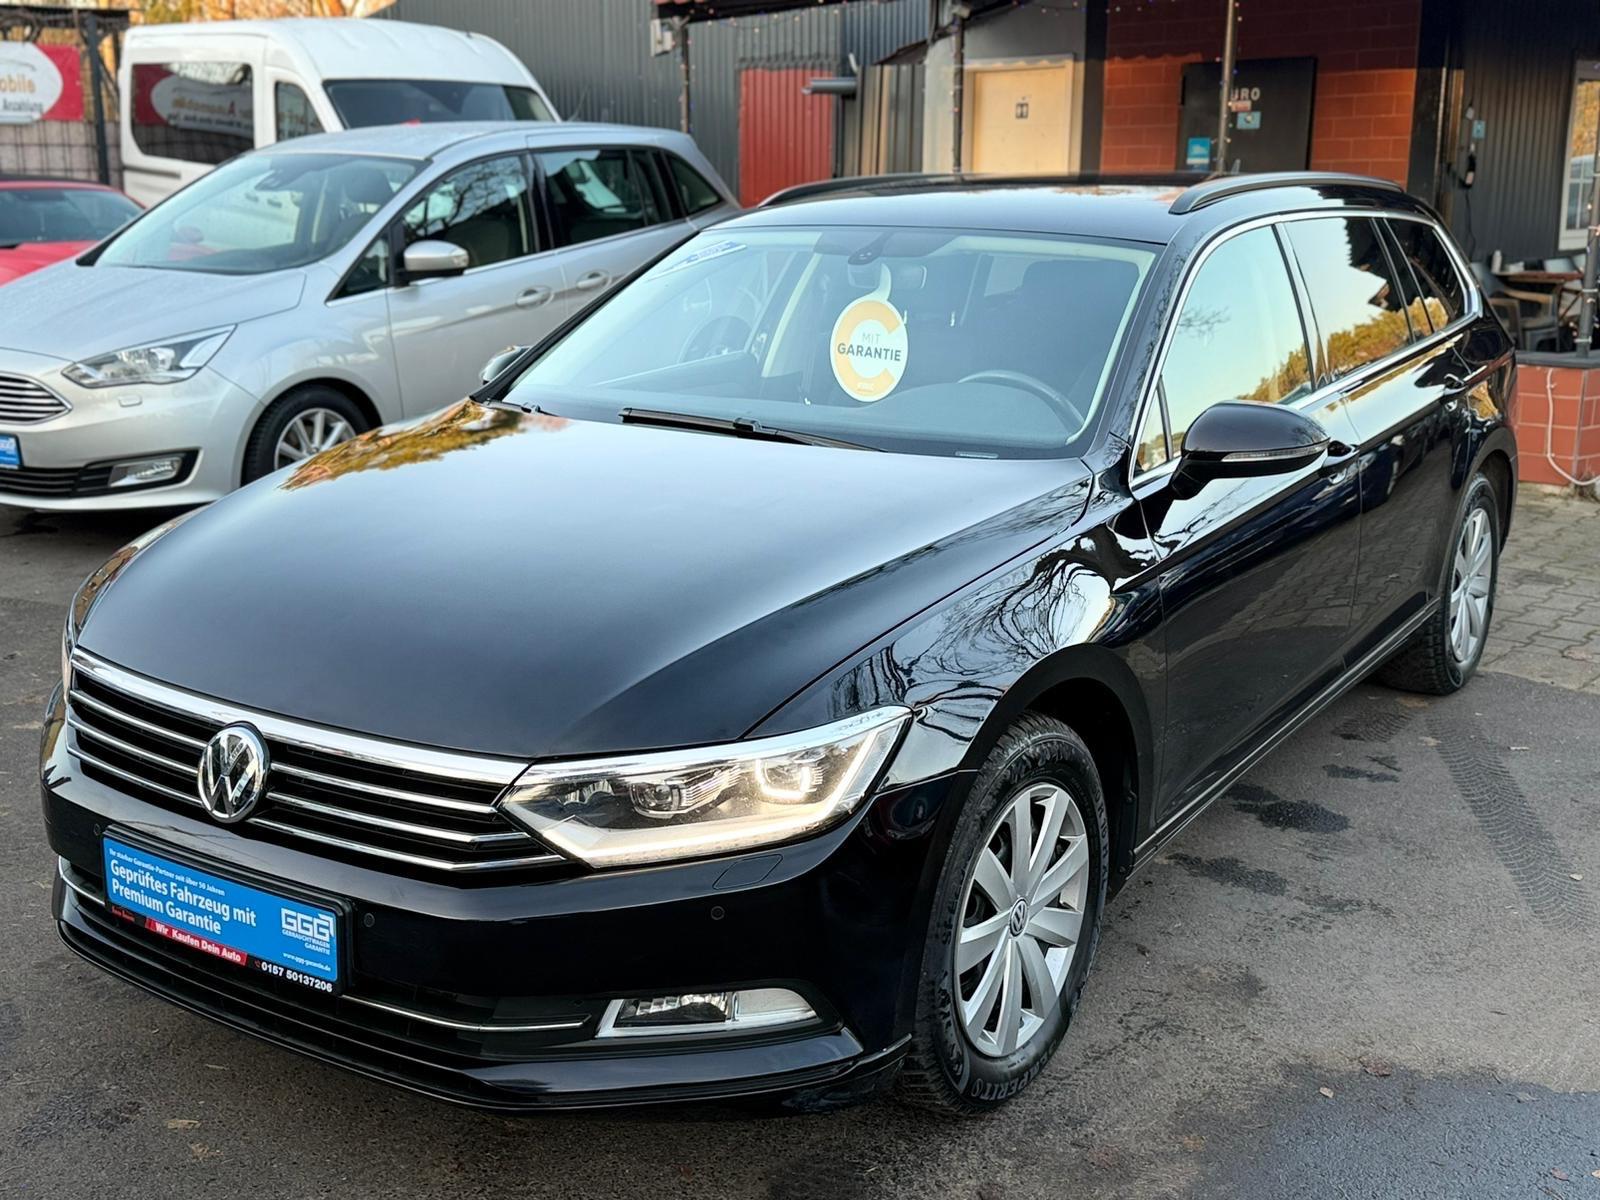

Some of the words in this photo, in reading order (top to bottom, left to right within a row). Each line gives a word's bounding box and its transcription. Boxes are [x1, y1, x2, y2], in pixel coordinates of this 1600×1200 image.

[837, 343, 902, 361] GARANTIE
[862, 333, 881, 344] MIT
[110, 859, 168, 896] Geprüftes
[170, 881, 230, 921] Fahrzeug
[233, 907, 256, 927] mit
[112, 877, 164, 913] Premium
[165, 901, 222, 935] Garantie
[155, 922, 169, 935] Wir
[171, 928, 200, 948] Kaufen
[200, 940, 220, 955] Dein
[220, 947, 242, 962] Auto
[281, 907, 332, 942] GGG
[261, 961, 284, 977] 0157
[286, 968, 333, 993] 50137206
